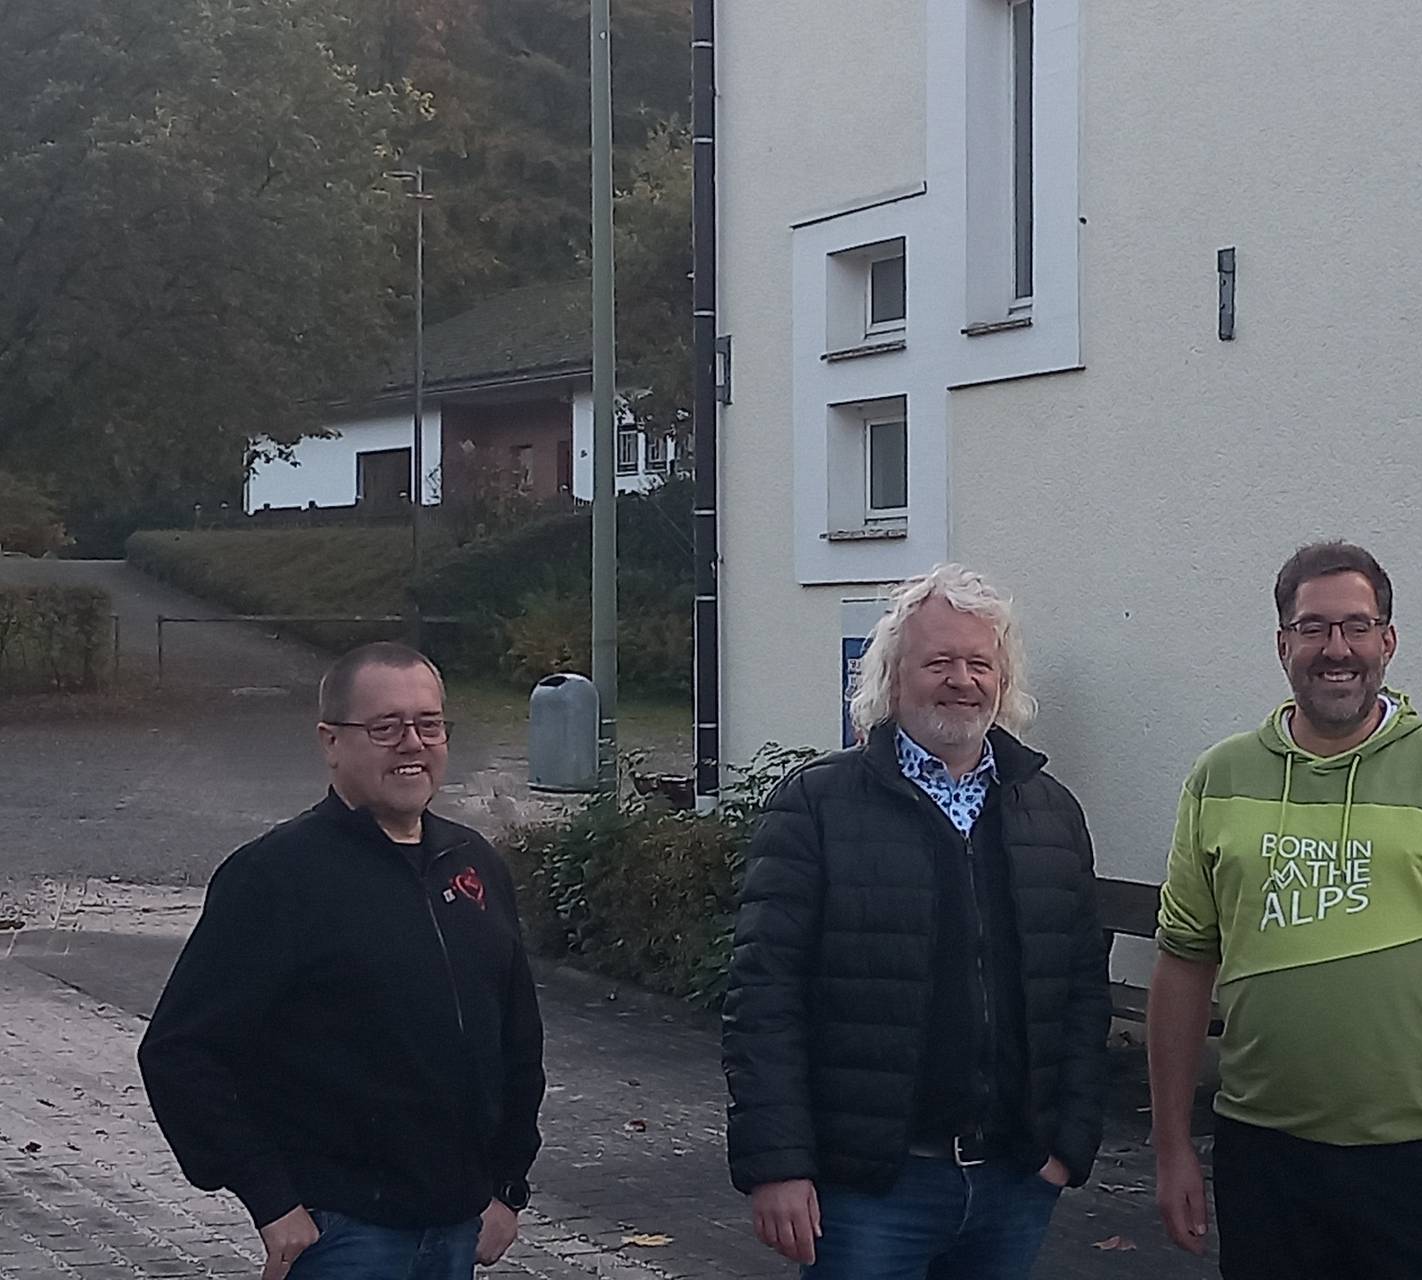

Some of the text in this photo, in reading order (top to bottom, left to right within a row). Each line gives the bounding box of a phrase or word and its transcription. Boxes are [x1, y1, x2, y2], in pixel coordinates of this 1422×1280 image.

[1262, 834, 1372, 859] BORN IN
[1306, 859, 1371, 886] THE
[1260, 883, 1369, 931] ALPS
